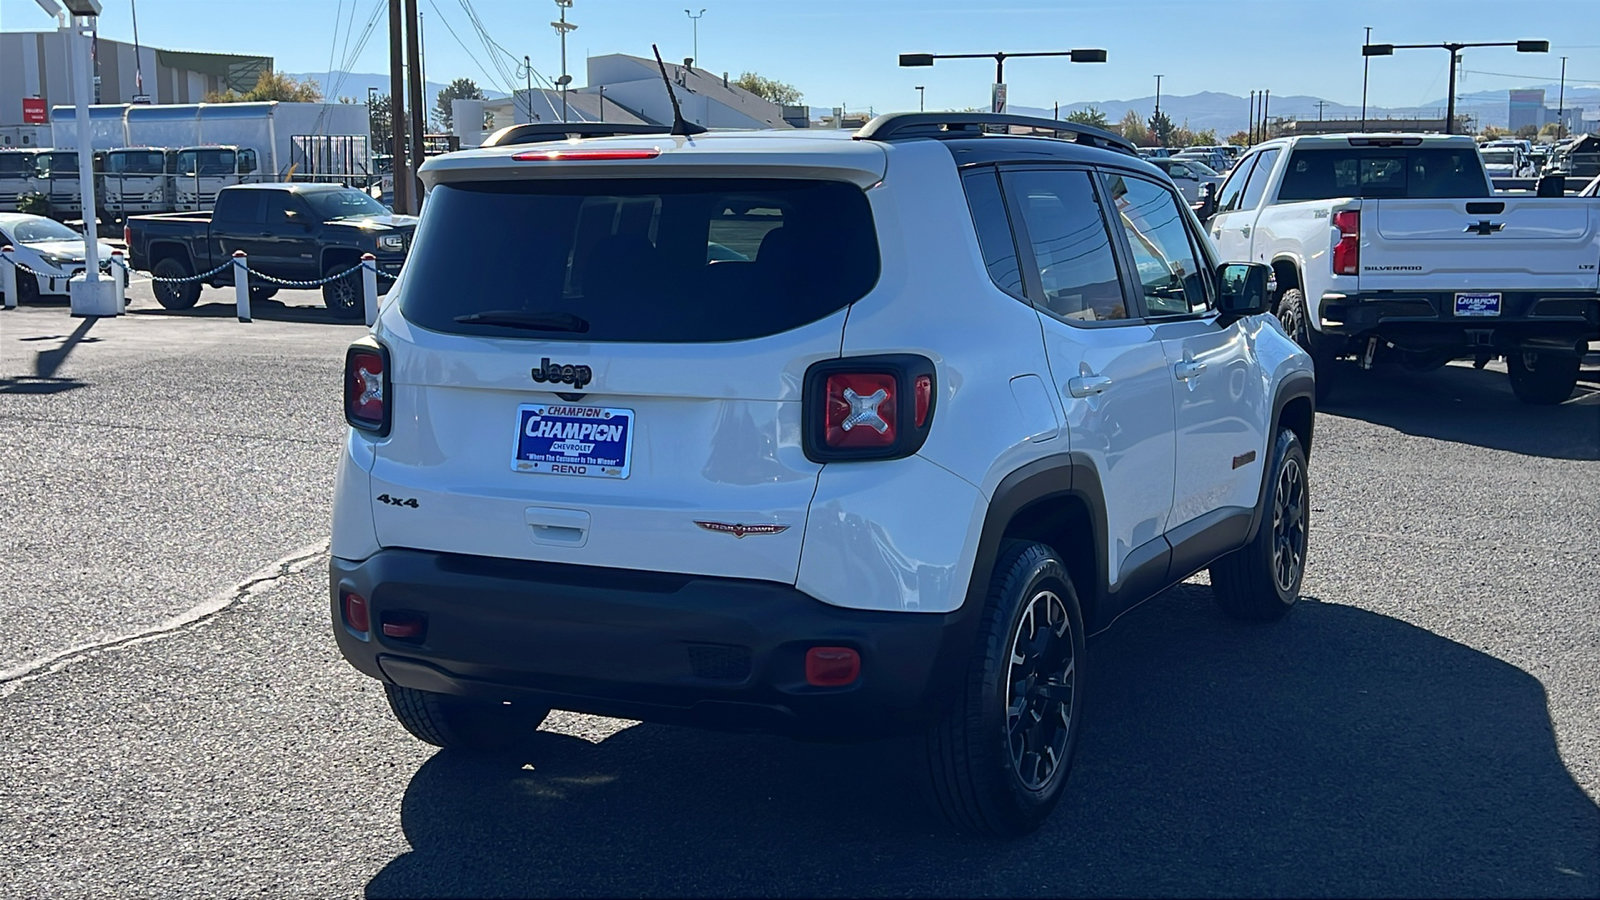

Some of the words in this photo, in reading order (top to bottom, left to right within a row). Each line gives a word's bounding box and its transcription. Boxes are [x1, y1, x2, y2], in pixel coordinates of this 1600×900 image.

[531, 358, 592, 389] Jeep
[548, 406, 601, 417] CHAMPION
[525, 416, 623, 442] CHAMPION
[553, 443, 591, 452] CHEVROLET
[551, 464, 587, 474] RENO
[376, 493, 420, 508] 4x4
